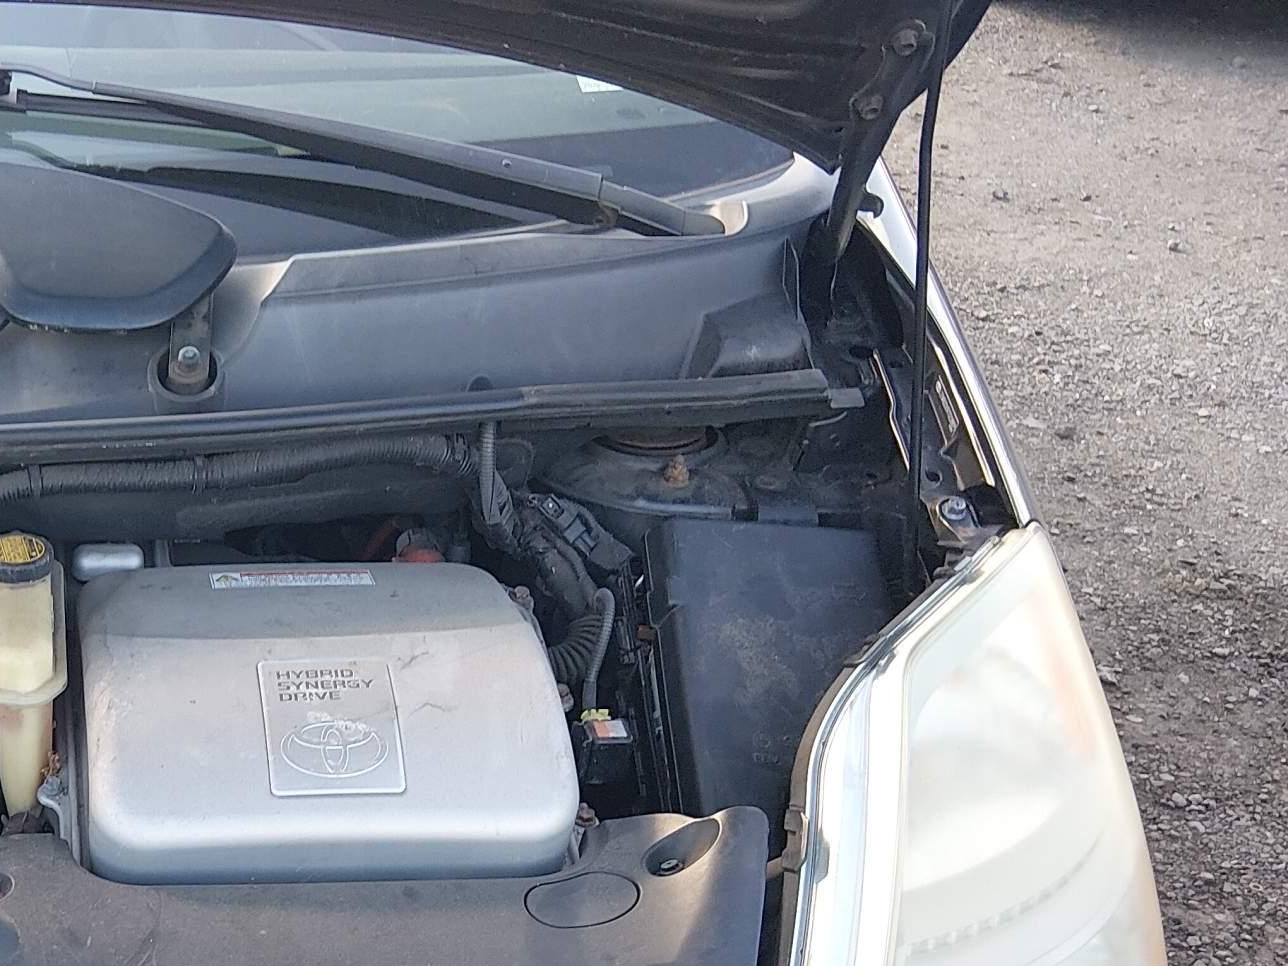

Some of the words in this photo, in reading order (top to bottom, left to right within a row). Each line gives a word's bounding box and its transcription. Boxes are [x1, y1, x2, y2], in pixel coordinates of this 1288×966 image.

[275, 669, 353, 680] HYBRID
[277, 679, 374, 690] SYNERGY
[278, 691, 341, 701] DRIVE
